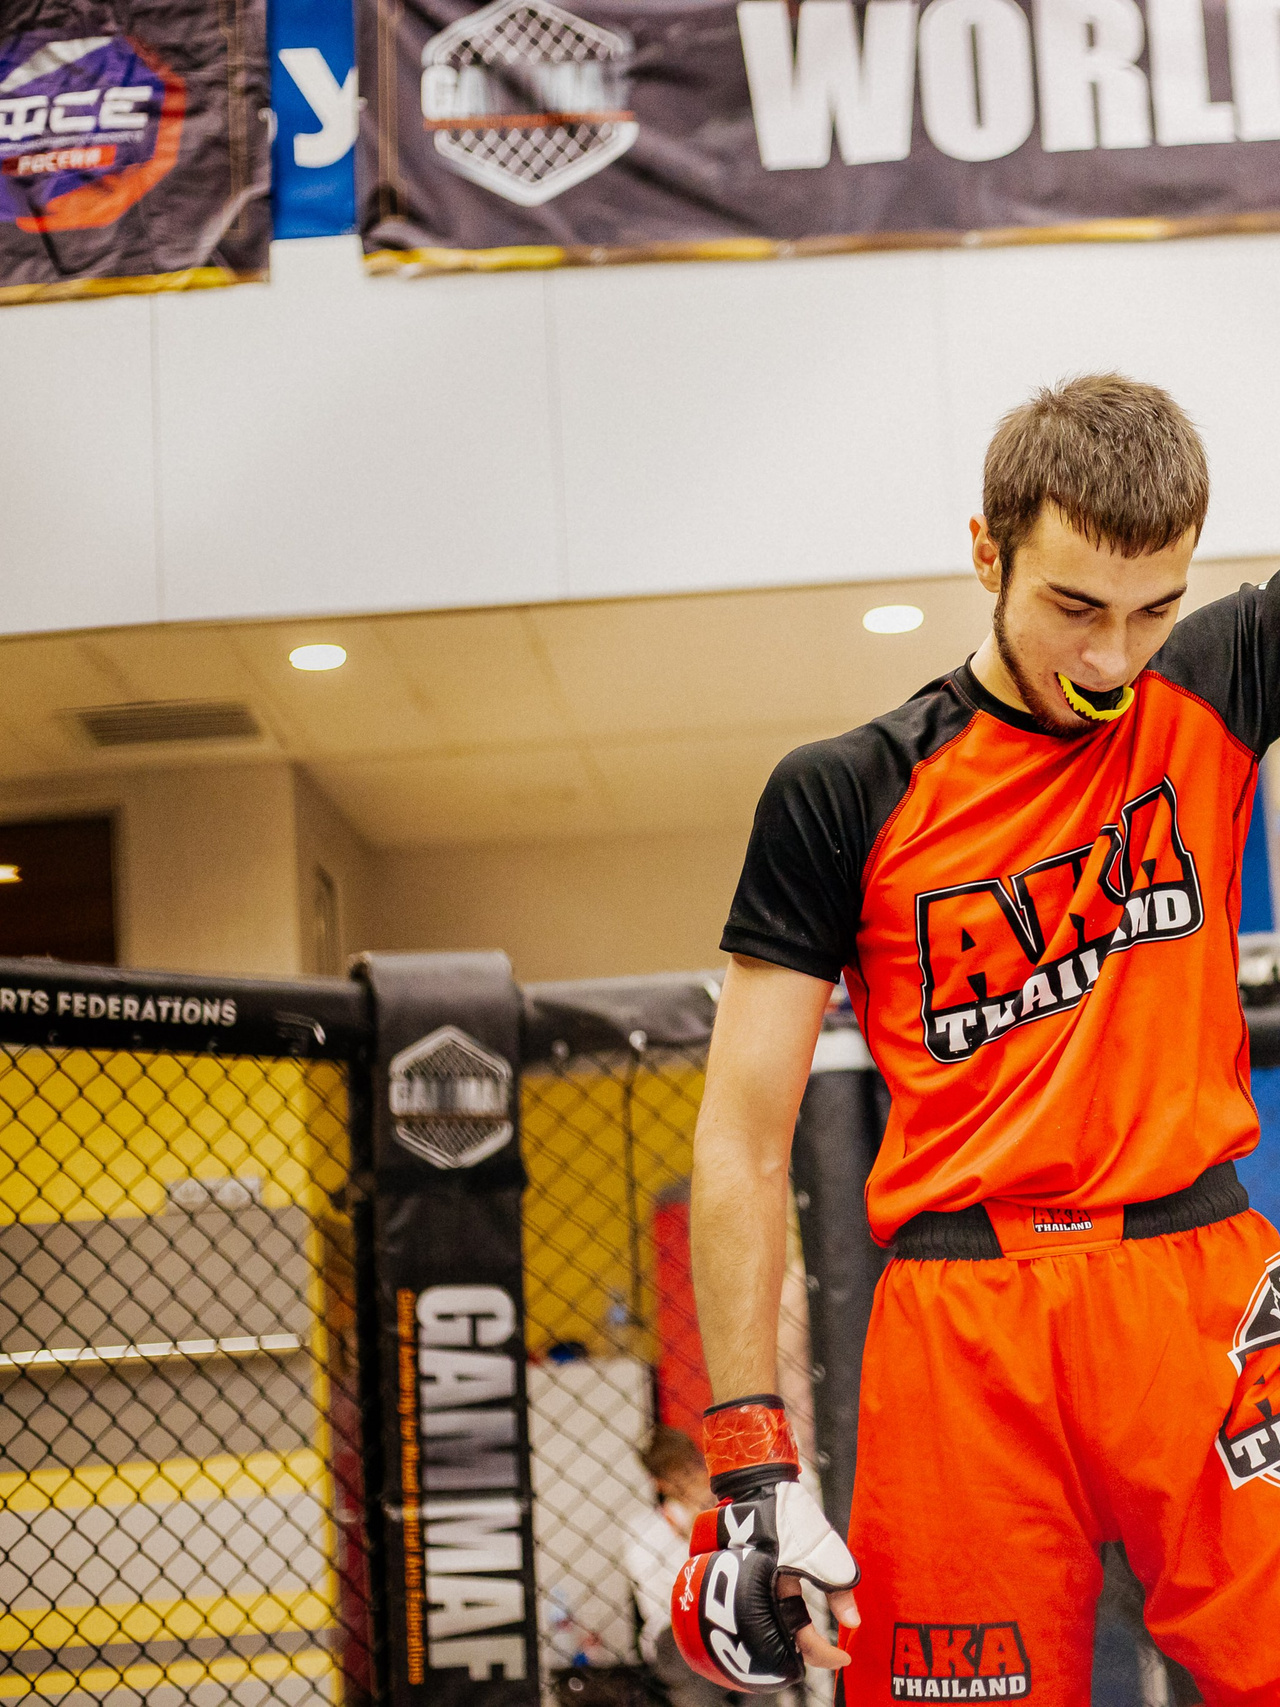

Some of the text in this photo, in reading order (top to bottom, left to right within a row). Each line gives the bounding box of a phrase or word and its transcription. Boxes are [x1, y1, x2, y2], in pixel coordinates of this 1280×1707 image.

[57, 991, 238, 1027] FEDERATIONS
[1035, 1221, 1093, 1232] THAILAND
[415, 1285, 525, 1682] GAMMAF
[892, 1622, 1027, 1677] AKA
[893, 1675, 1027, 1698] THAILAND
